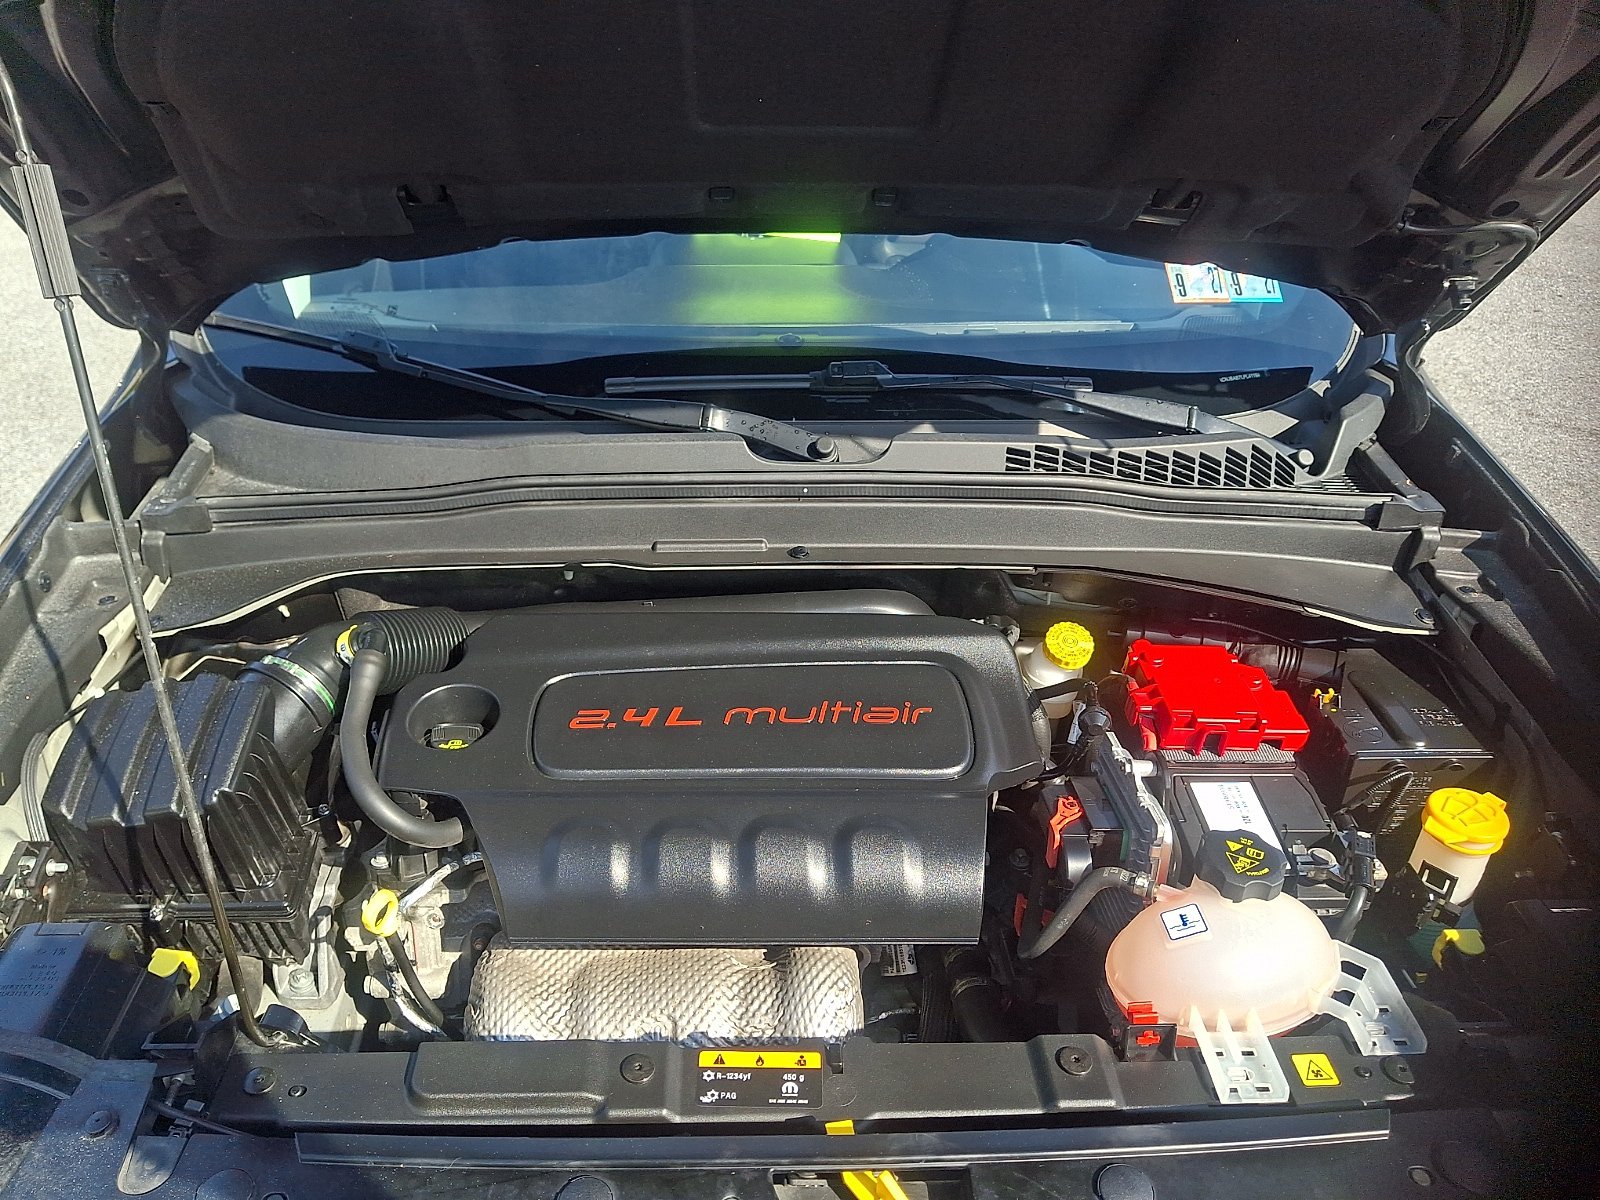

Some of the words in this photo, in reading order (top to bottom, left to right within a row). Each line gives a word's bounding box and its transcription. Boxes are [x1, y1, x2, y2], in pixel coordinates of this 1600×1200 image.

[1175, 272, 1187, 297] 9
[1207, 266, 1223, 294] 27
[1231, 272, 1243, 296] 9
[568, 706, 703, 730] 2.4L
[723, 700, 933, 726] multiair
[716, 1072, 752, 1082] R-1234yf
[782, 1073, 797, 1081] 450
[799, 1074, 805, 1083] g
[720, 1092, 737, 1100] PAG
